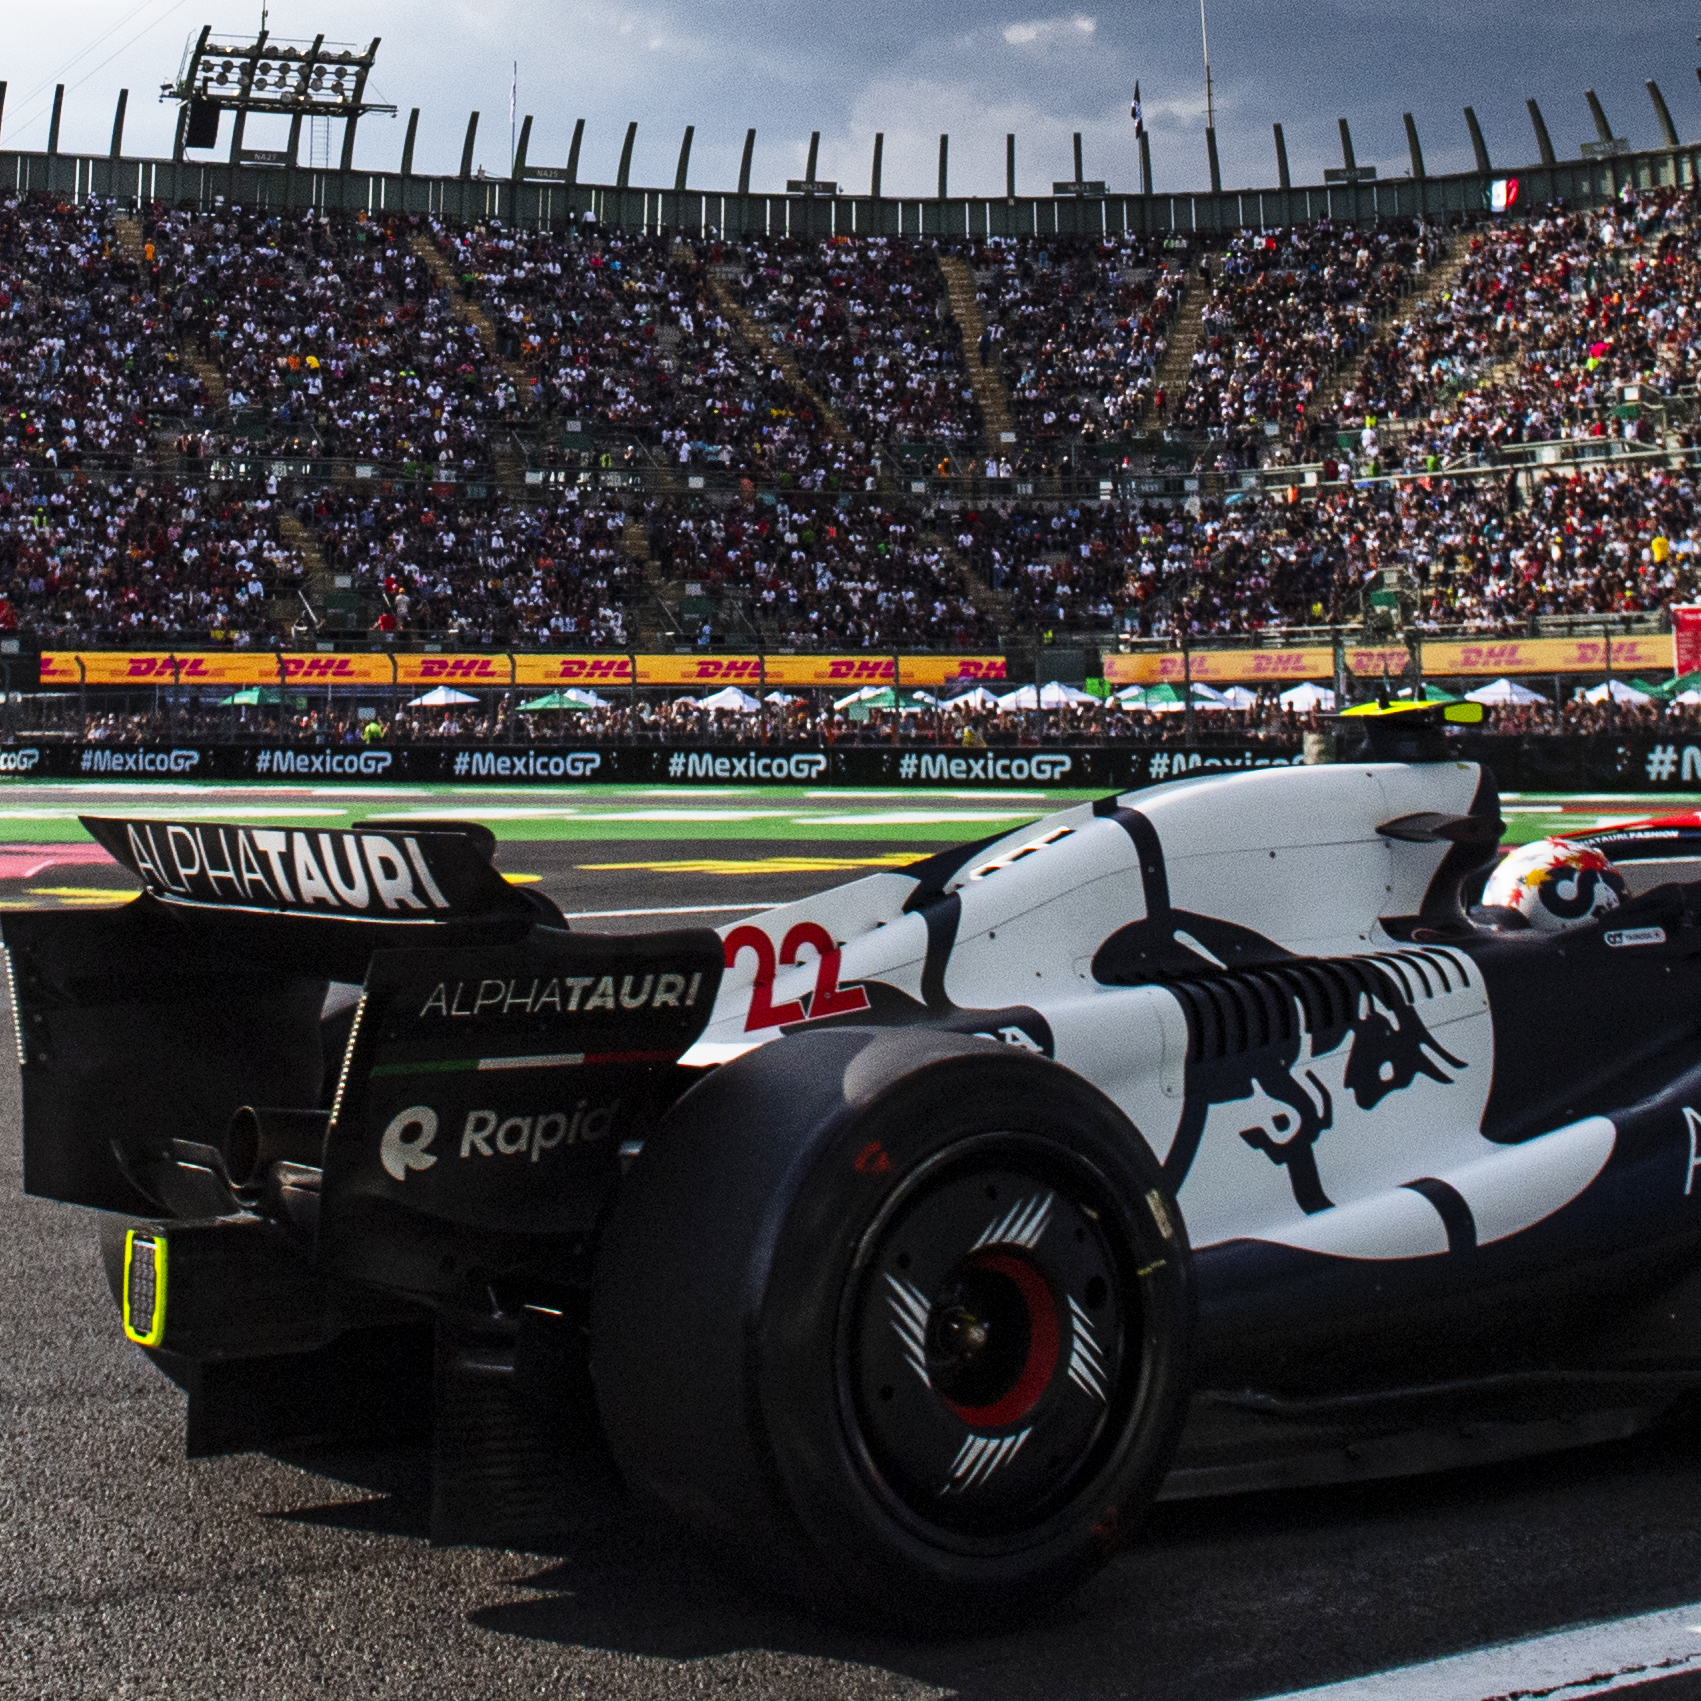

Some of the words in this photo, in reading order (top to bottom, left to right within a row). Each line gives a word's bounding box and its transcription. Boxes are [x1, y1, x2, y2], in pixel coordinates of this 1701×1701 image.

[1251, 653, 1307, 674] DHL
[1460, 644, 1523, 668] DHL
[1577, 641, 1646, 664] DHL
[128, 657, 209, 677] DHL
[277, 658, 356, 677] DHL
[419, 658, 498, 678] DHL
[559, 659, 634, 678] DHL
[696, 660, 767, 679] DHL
[829, 660, 896, 679] DHL
[80, 747, 201, 772] #MexicoGP
[256, 748, 393, 774] #MexicoGP
[453, 749, 602, 777] #MexicoGP
[668, 751, 828, 780] #MexicoGP
[899, 751, 1073, 781] #MexicoGP
[126, 822, 451, 909] ALPHATAURI
[723, 922, 872, 1033] 22
[419, 972, 703, 1019] ALPHATAURI
[459, 1098, 621, 1164] Rapid
